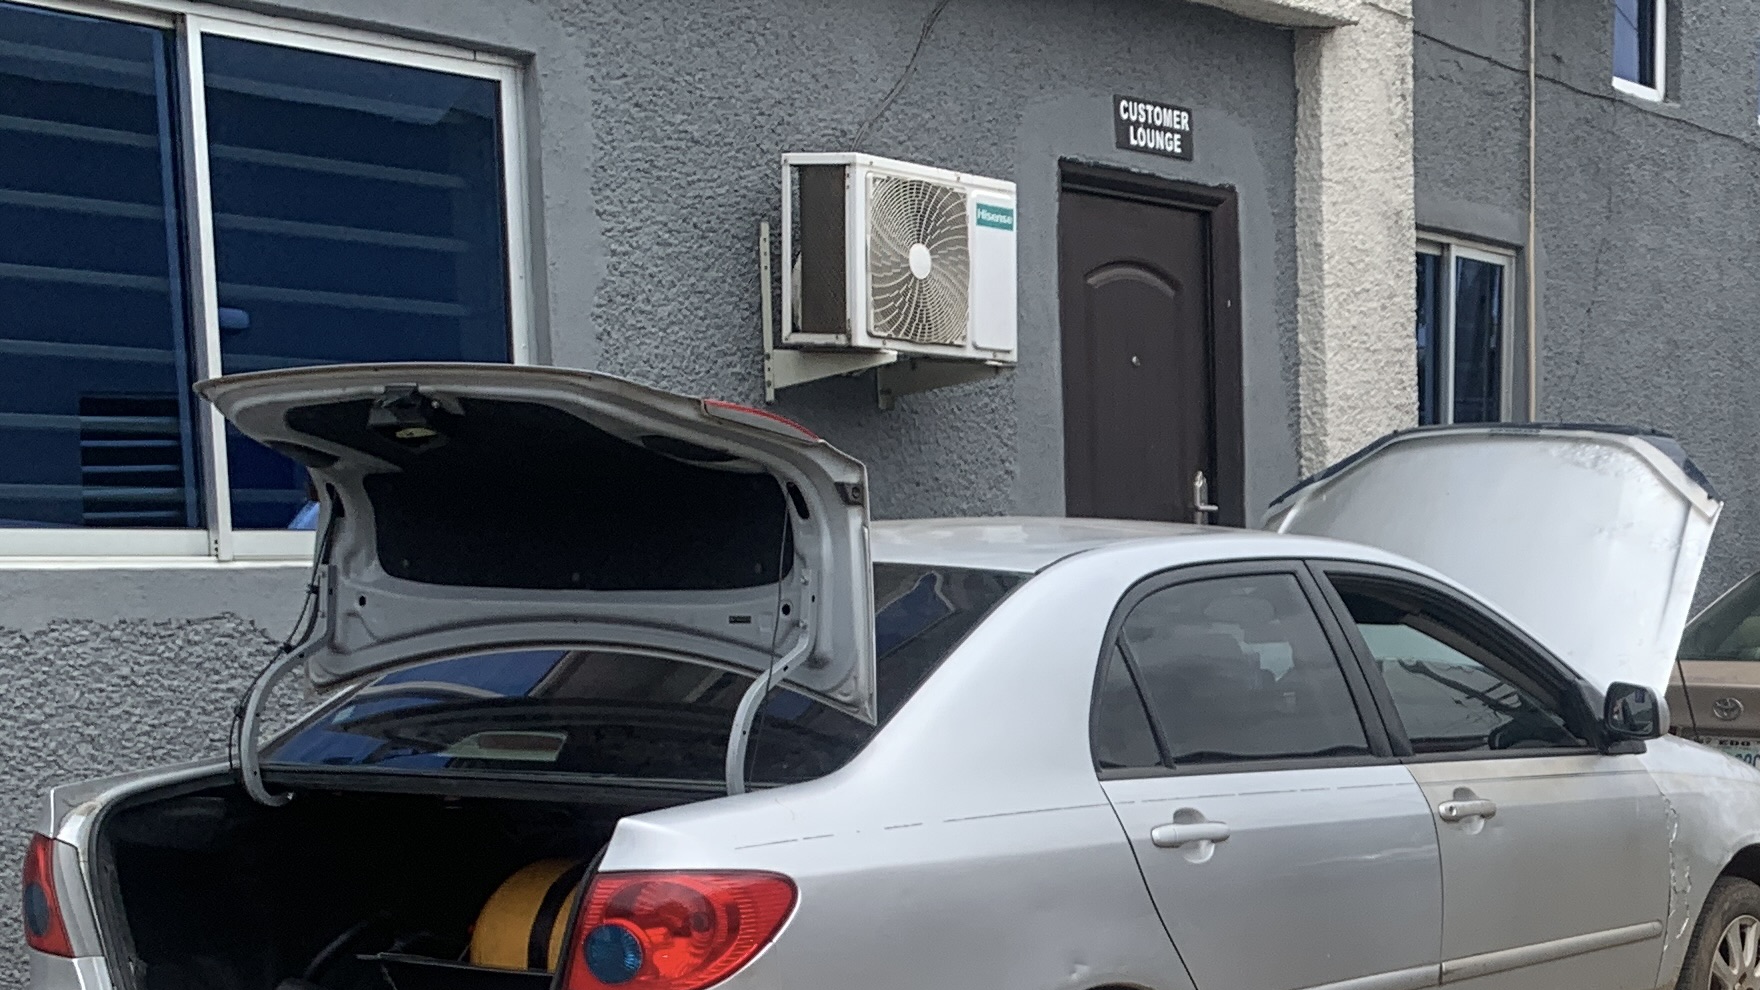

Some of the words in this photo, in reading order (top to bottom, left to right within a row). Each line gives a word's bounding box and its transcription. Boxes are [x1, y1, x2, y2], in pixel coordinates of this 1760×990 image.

[1120, 99, 1190, 131] CUSTOMER
[1129, 124, 1182, 153] LOUNGE
[977, 207, 1013, 225] Hisense
